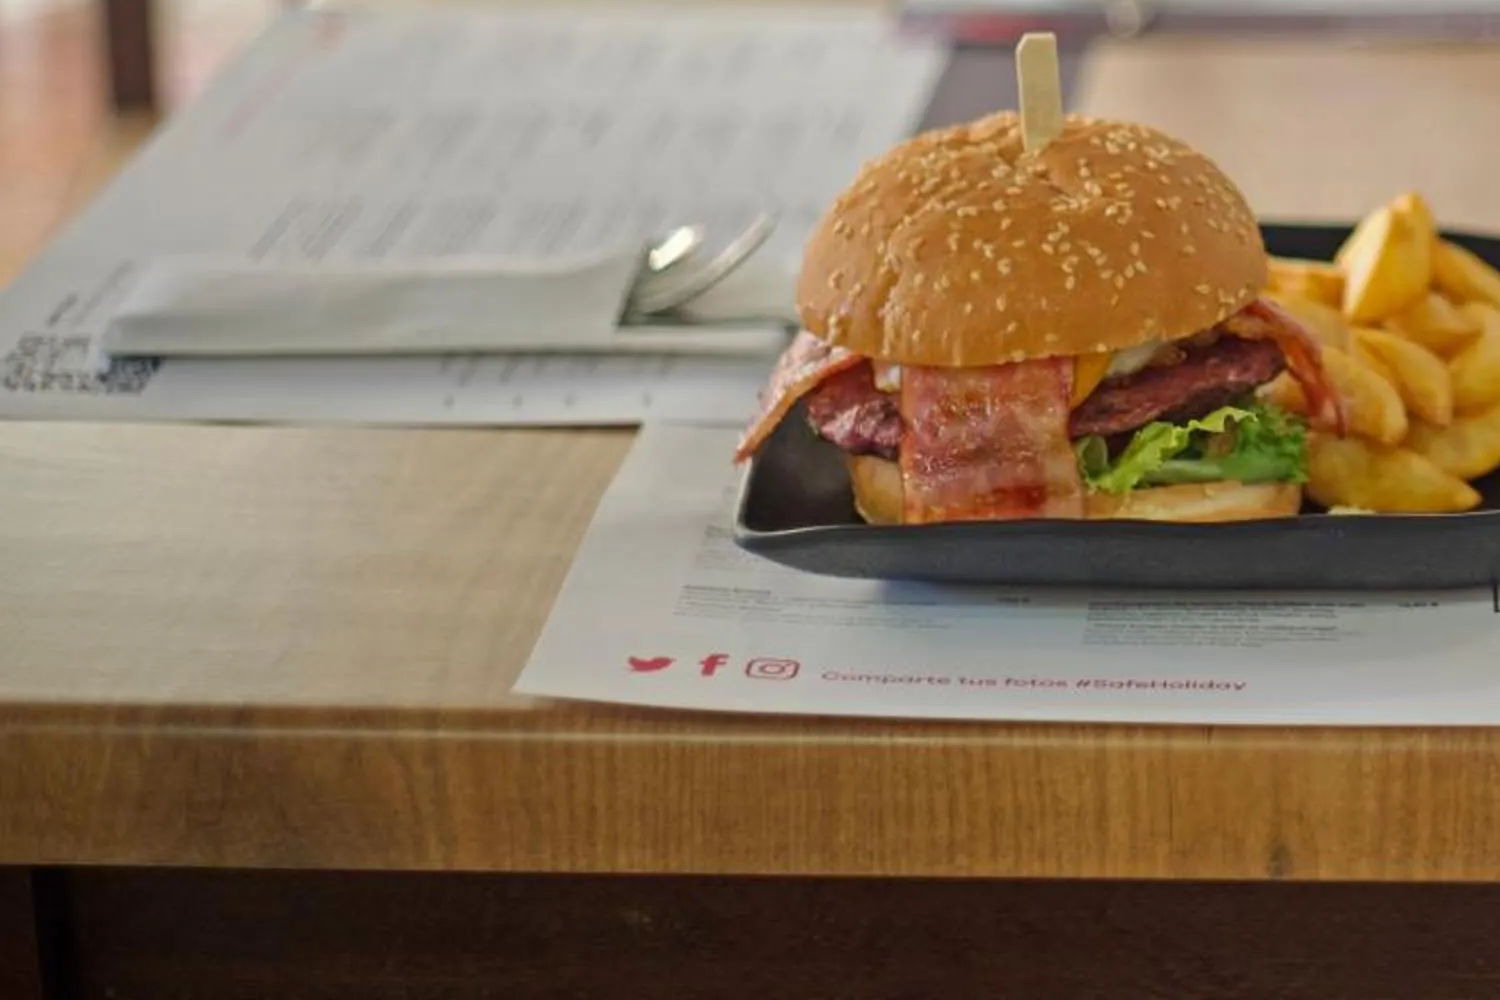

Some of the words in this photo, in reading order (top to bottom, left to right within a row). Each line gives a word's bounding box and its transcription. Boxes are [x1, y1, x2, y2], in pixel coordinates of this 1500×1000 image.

[821, 670, 951, 685] Comparte
[959, 676, 997, 687] tus
[1005, 677, 1069, 688] fotos
[1076, 678, 1247, 691] #SafeHoliday
